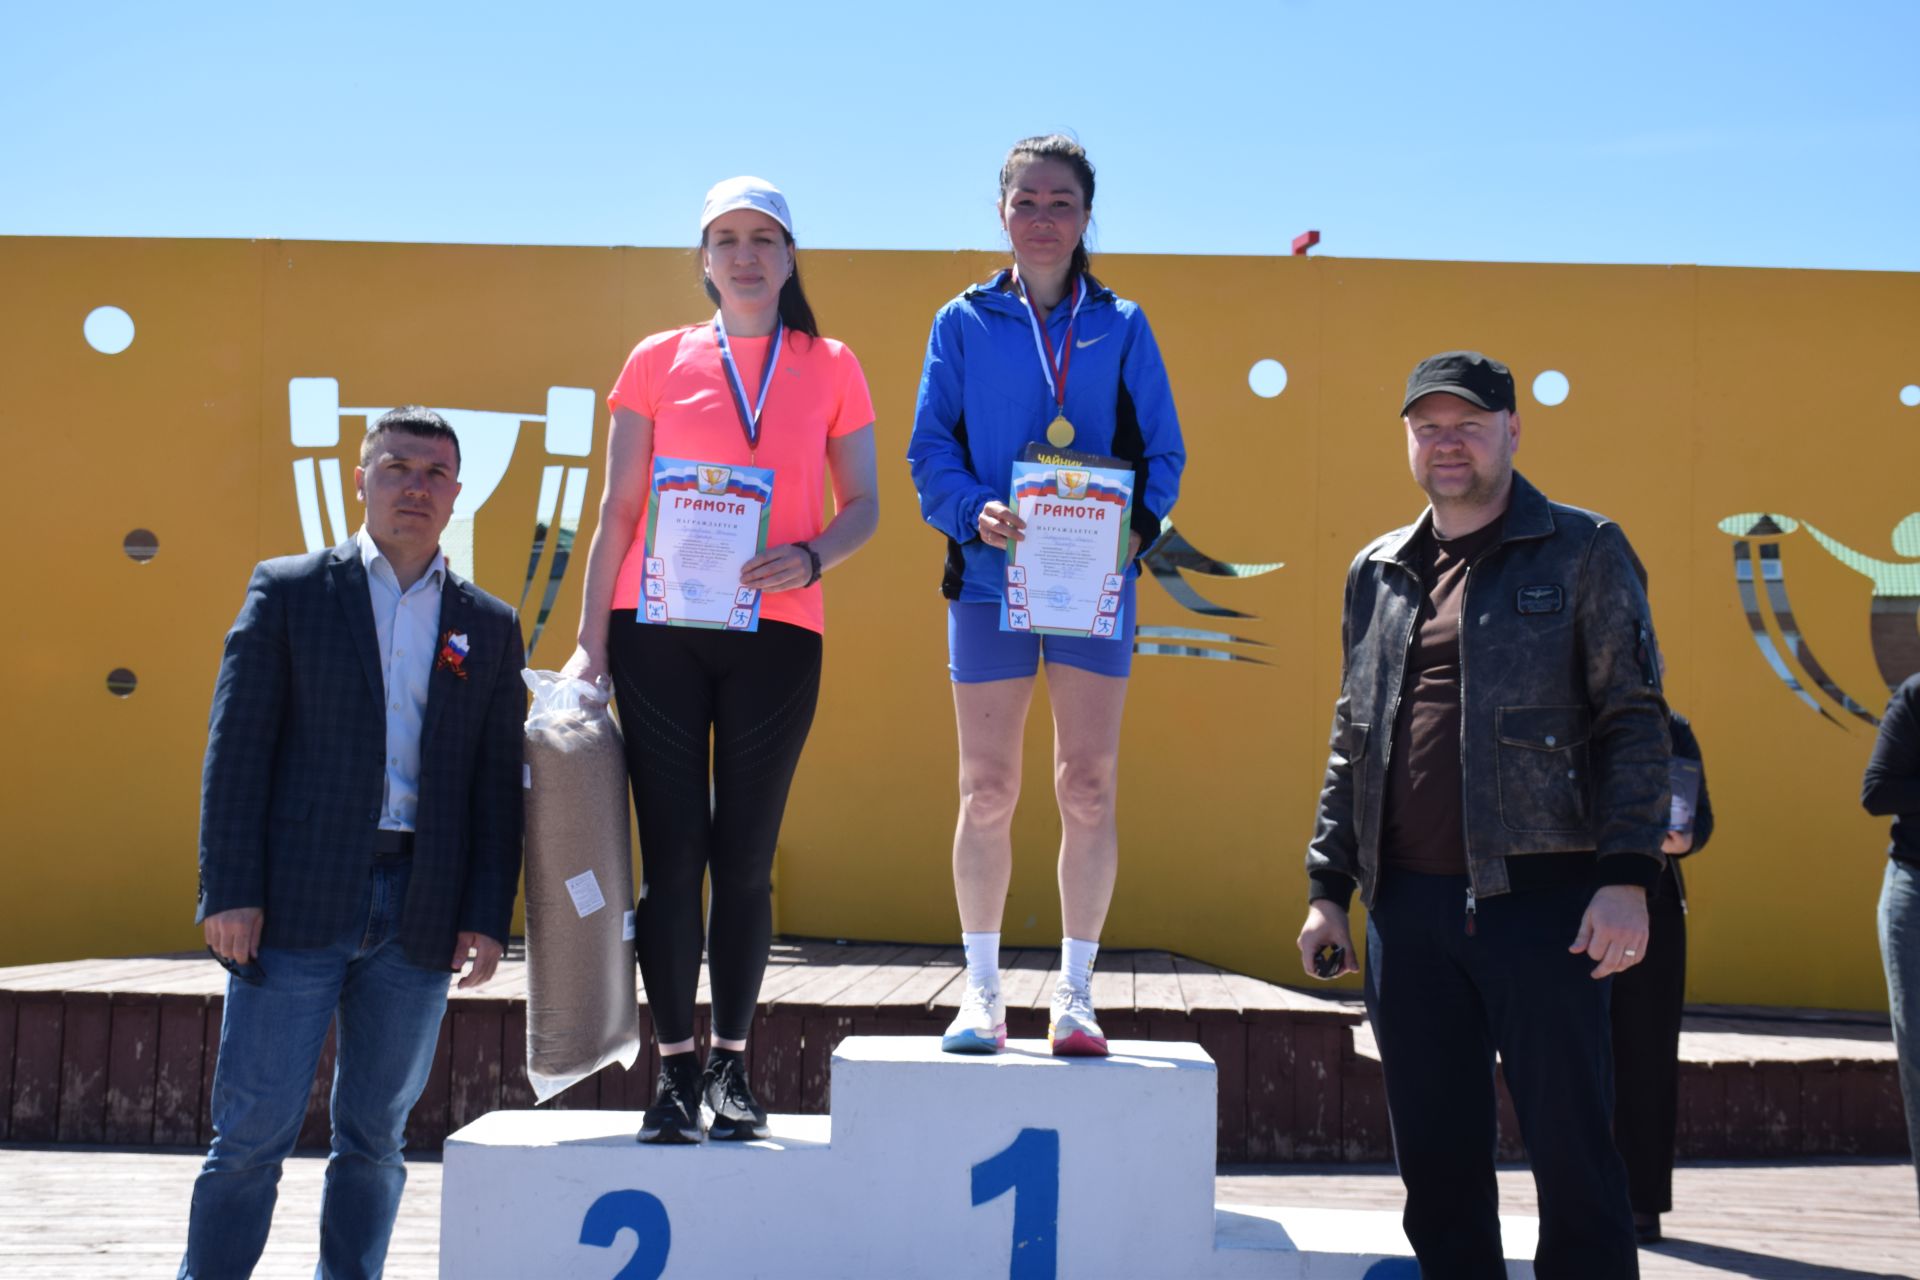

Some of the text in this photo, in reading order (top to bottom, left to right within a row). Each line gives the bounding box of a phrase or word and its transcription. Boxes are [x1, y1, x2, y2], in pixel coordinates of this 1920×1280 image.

[674, 497, 745, 515] ГРАМОТА
[1034, 503, 1105, 520] ГРАМОТА
[971, 1127, 1060, 1280] 1
[579, 1188, 671, 1280] 2
